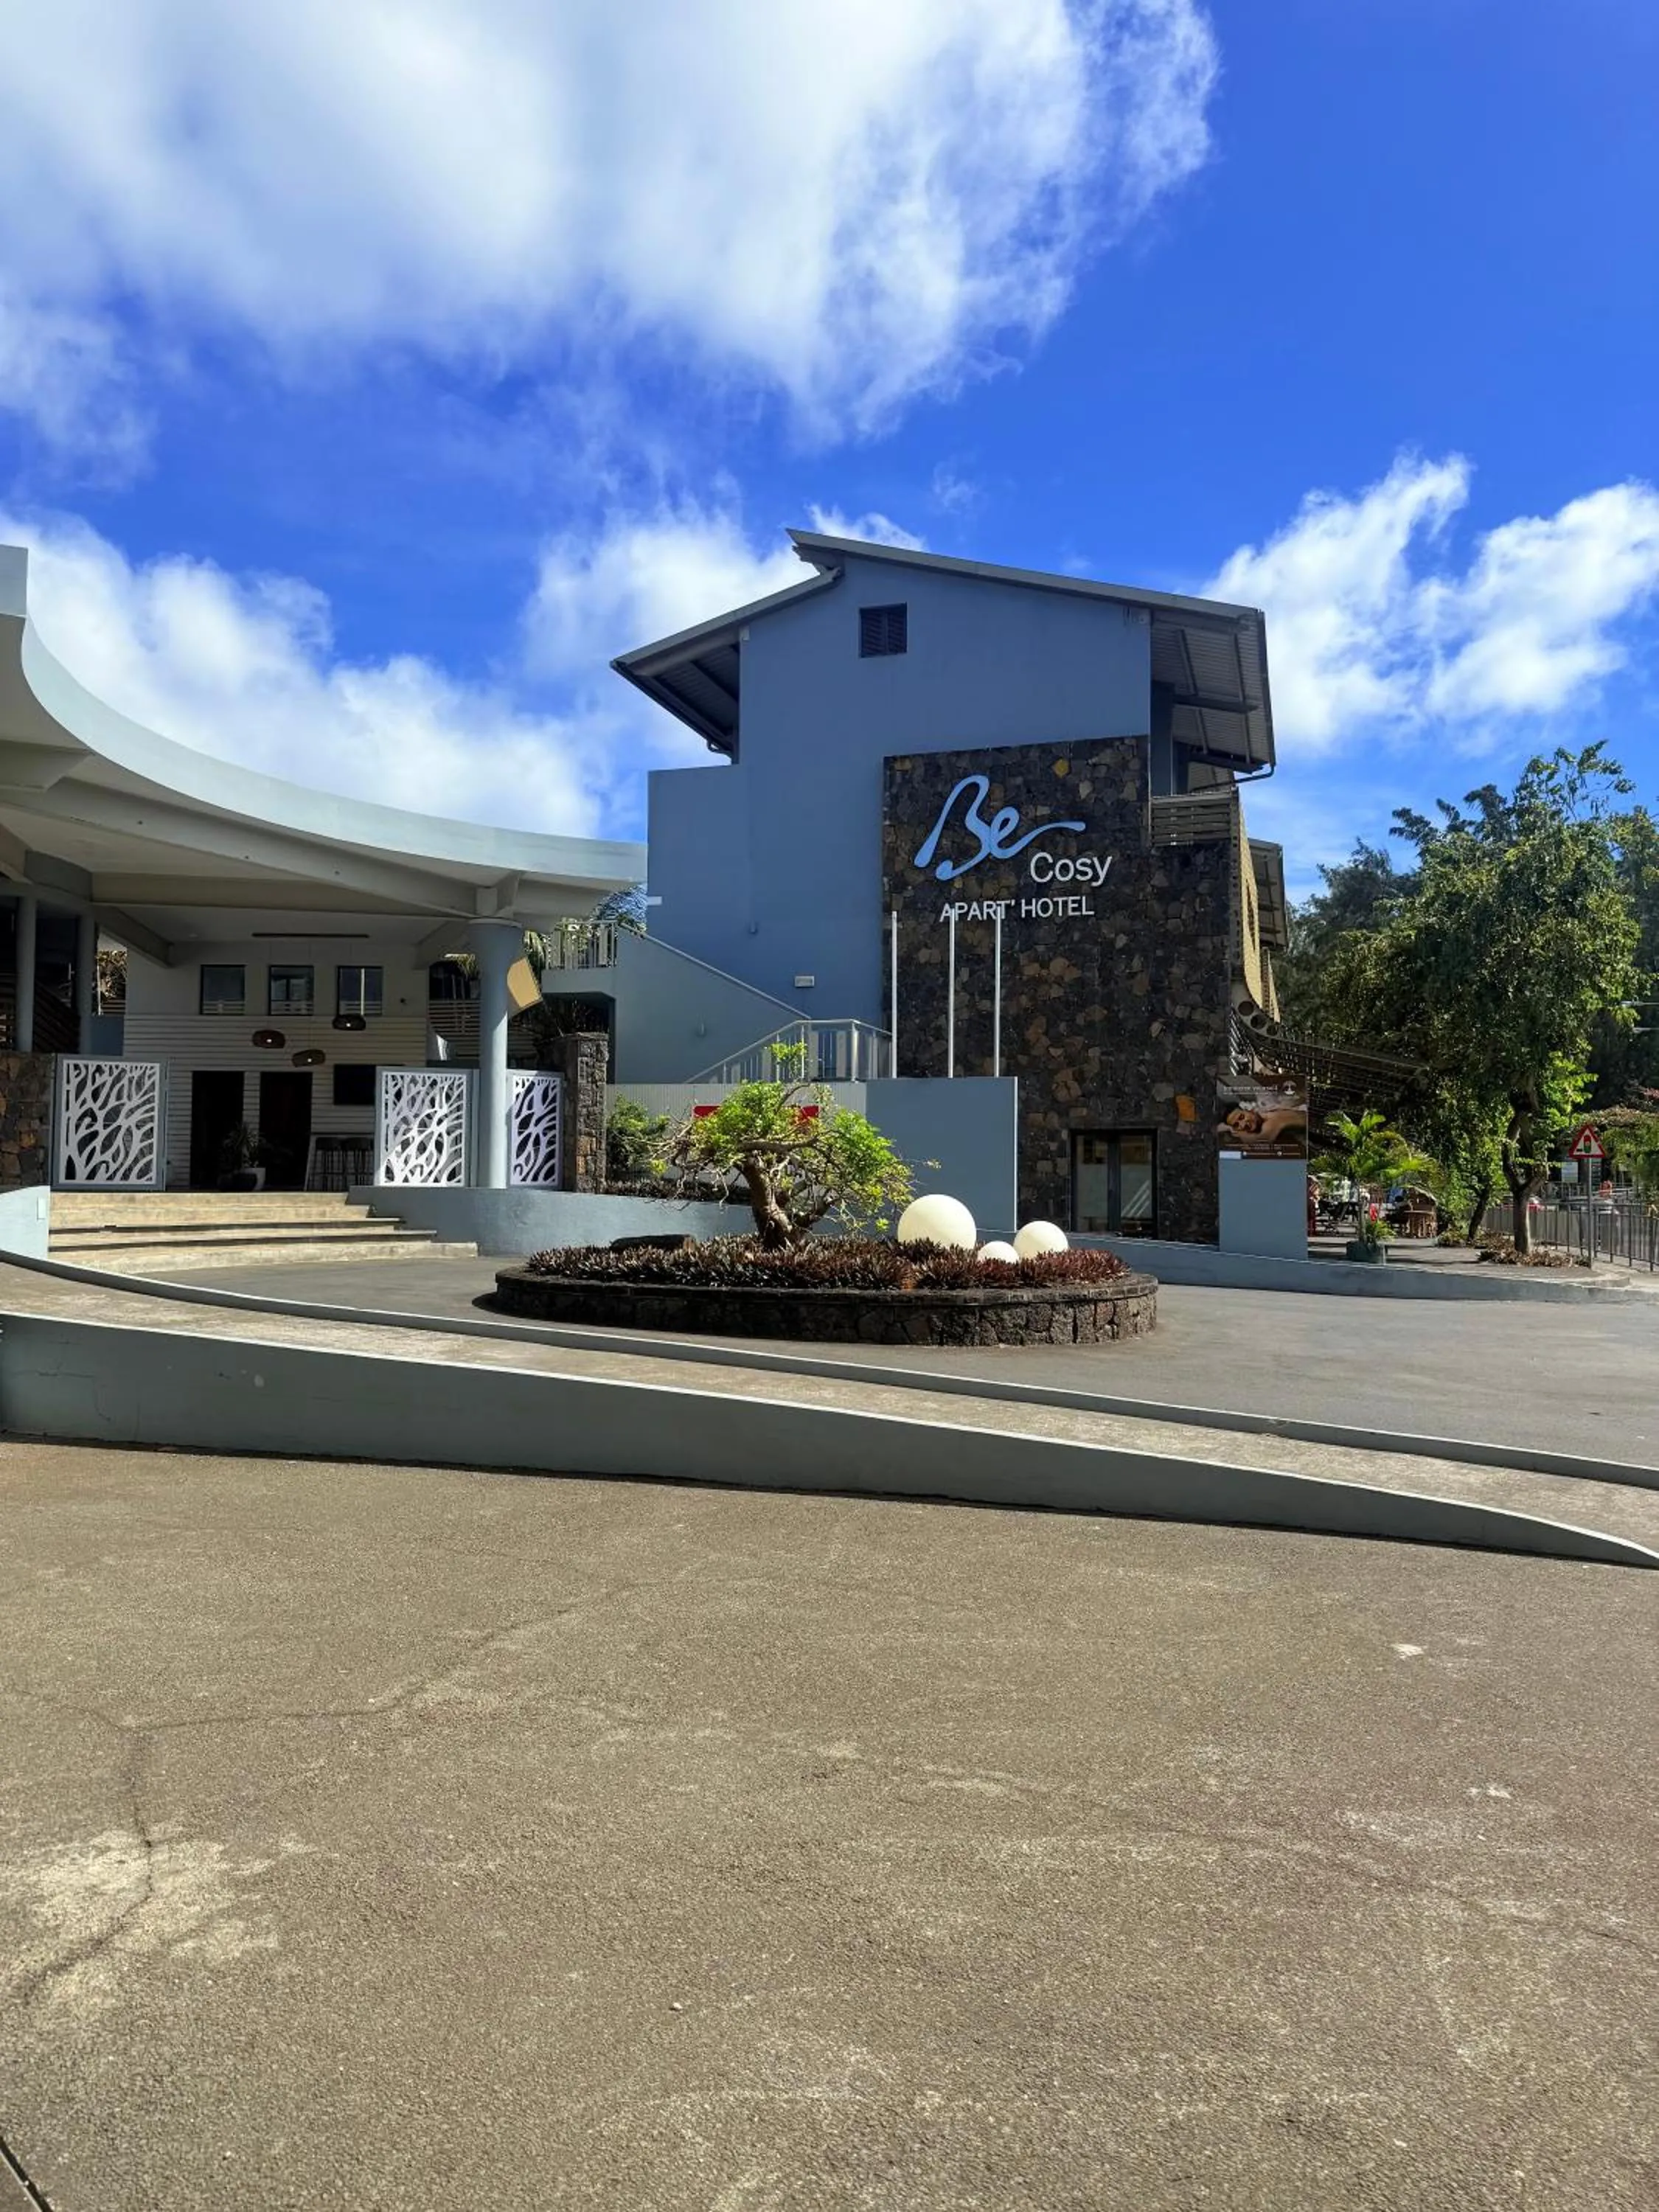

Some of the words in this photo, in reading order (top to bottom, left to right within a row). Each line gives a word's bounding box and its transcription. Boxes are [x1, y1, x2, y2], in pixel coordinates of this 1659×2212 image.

[914, 774, 1086, 881] Be
[1029, 852, 1113, 886] Cosy
[939, 899, 1015, 922] APART'
[1020, 896, 1095, 919] HOTEL
